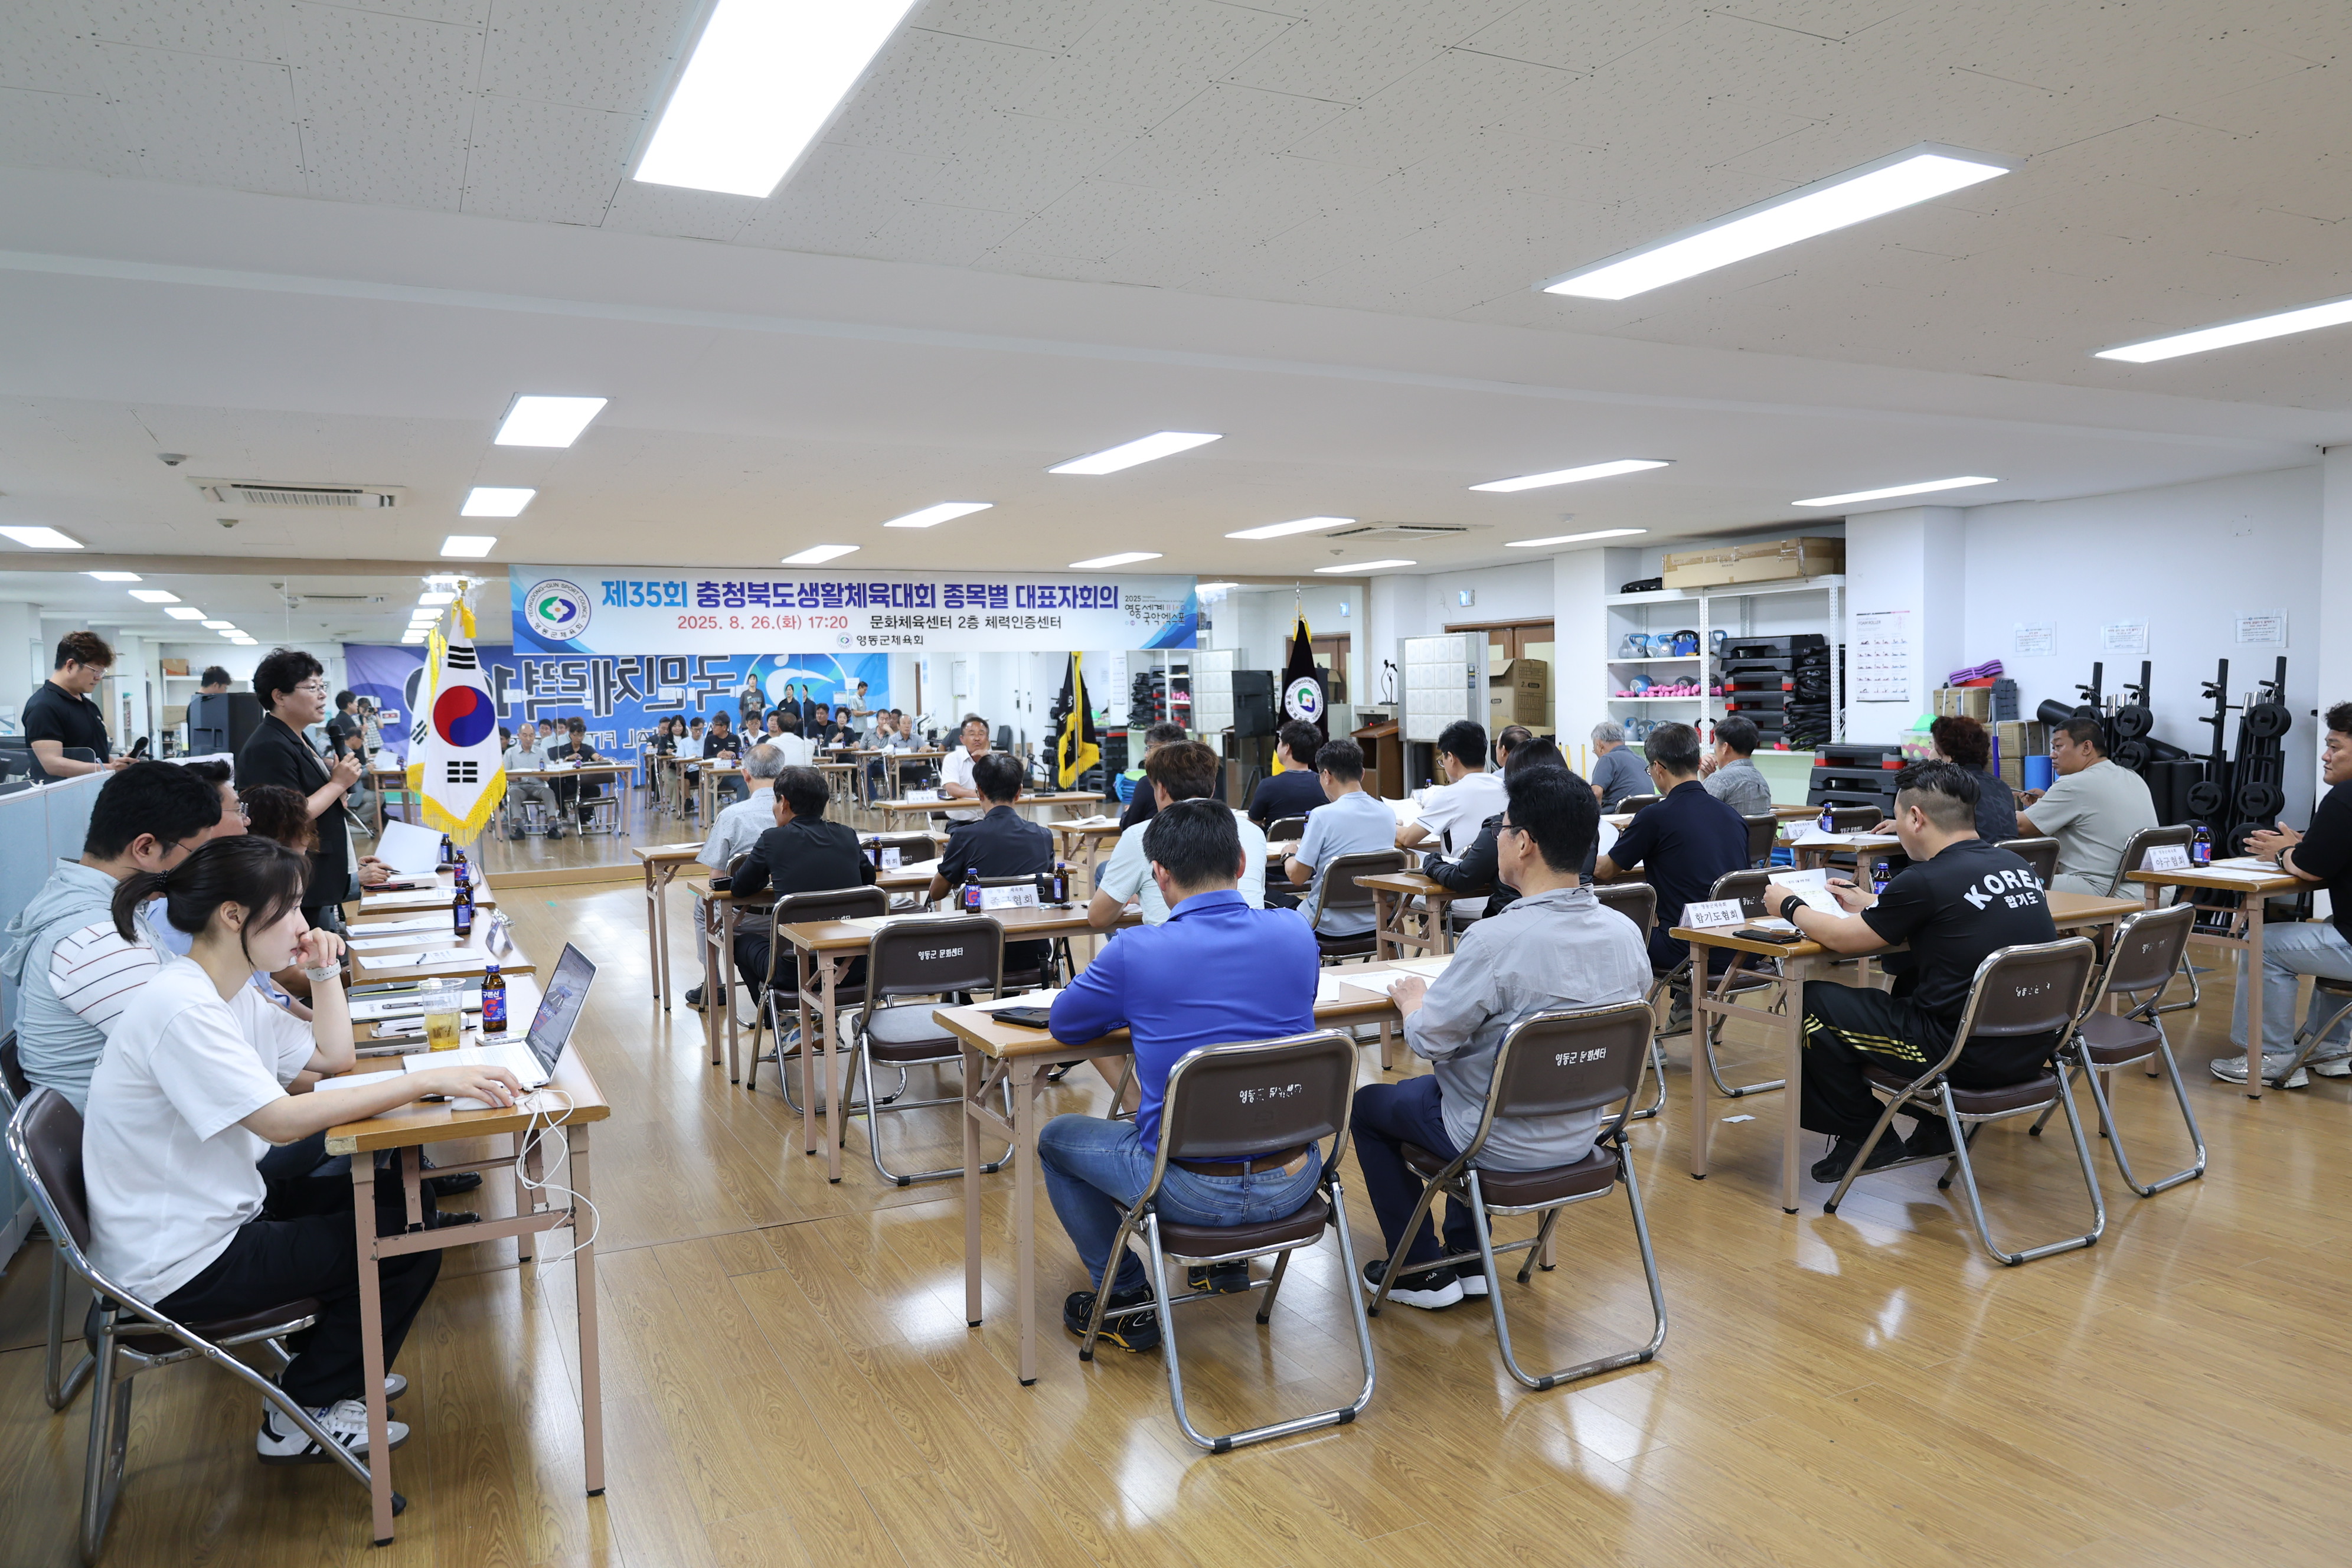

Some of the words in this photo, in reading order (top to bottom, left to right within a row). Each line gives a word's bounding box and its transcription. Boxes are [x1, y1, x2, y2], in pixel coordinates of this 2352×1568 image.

[561, 583, 580, 595] SPORT
[578, 595, 588, 619] COUNCIL
[601, 580, 688, 608] 제35회
[697, 582, 936, 609] 충청북도생활체육대회
[944, 584, 1008, 609] 종목별
[1016, 585, 1119, 610] 대표자회의
[677, 616, 723, 629] 2025.
[729, 616, 745, 629] 8.
[808, 616, 848, 629] 17:20
[870, 615, 952, 630] 문화체육센터
[958, 615, 979, 630] 2층
[985, 615, 1061, 630] 체력인증센터
[857, 634, 924, 647] 영동군체육회
[2155, 855, 2186, 868] 야구협회
[1963, 868, 2046, 910] KOREA
[2003, 891, 2039, 909] 합기도
[1695, 909, 1739, 924] 합기도협회
[918, 950, 937, 961] 영동군
[939, 947, 963, 959] 문화센타
[1555, 1052, 1578, 1067] 영동군
[1425, 1272, 1438, 1282] FILA
